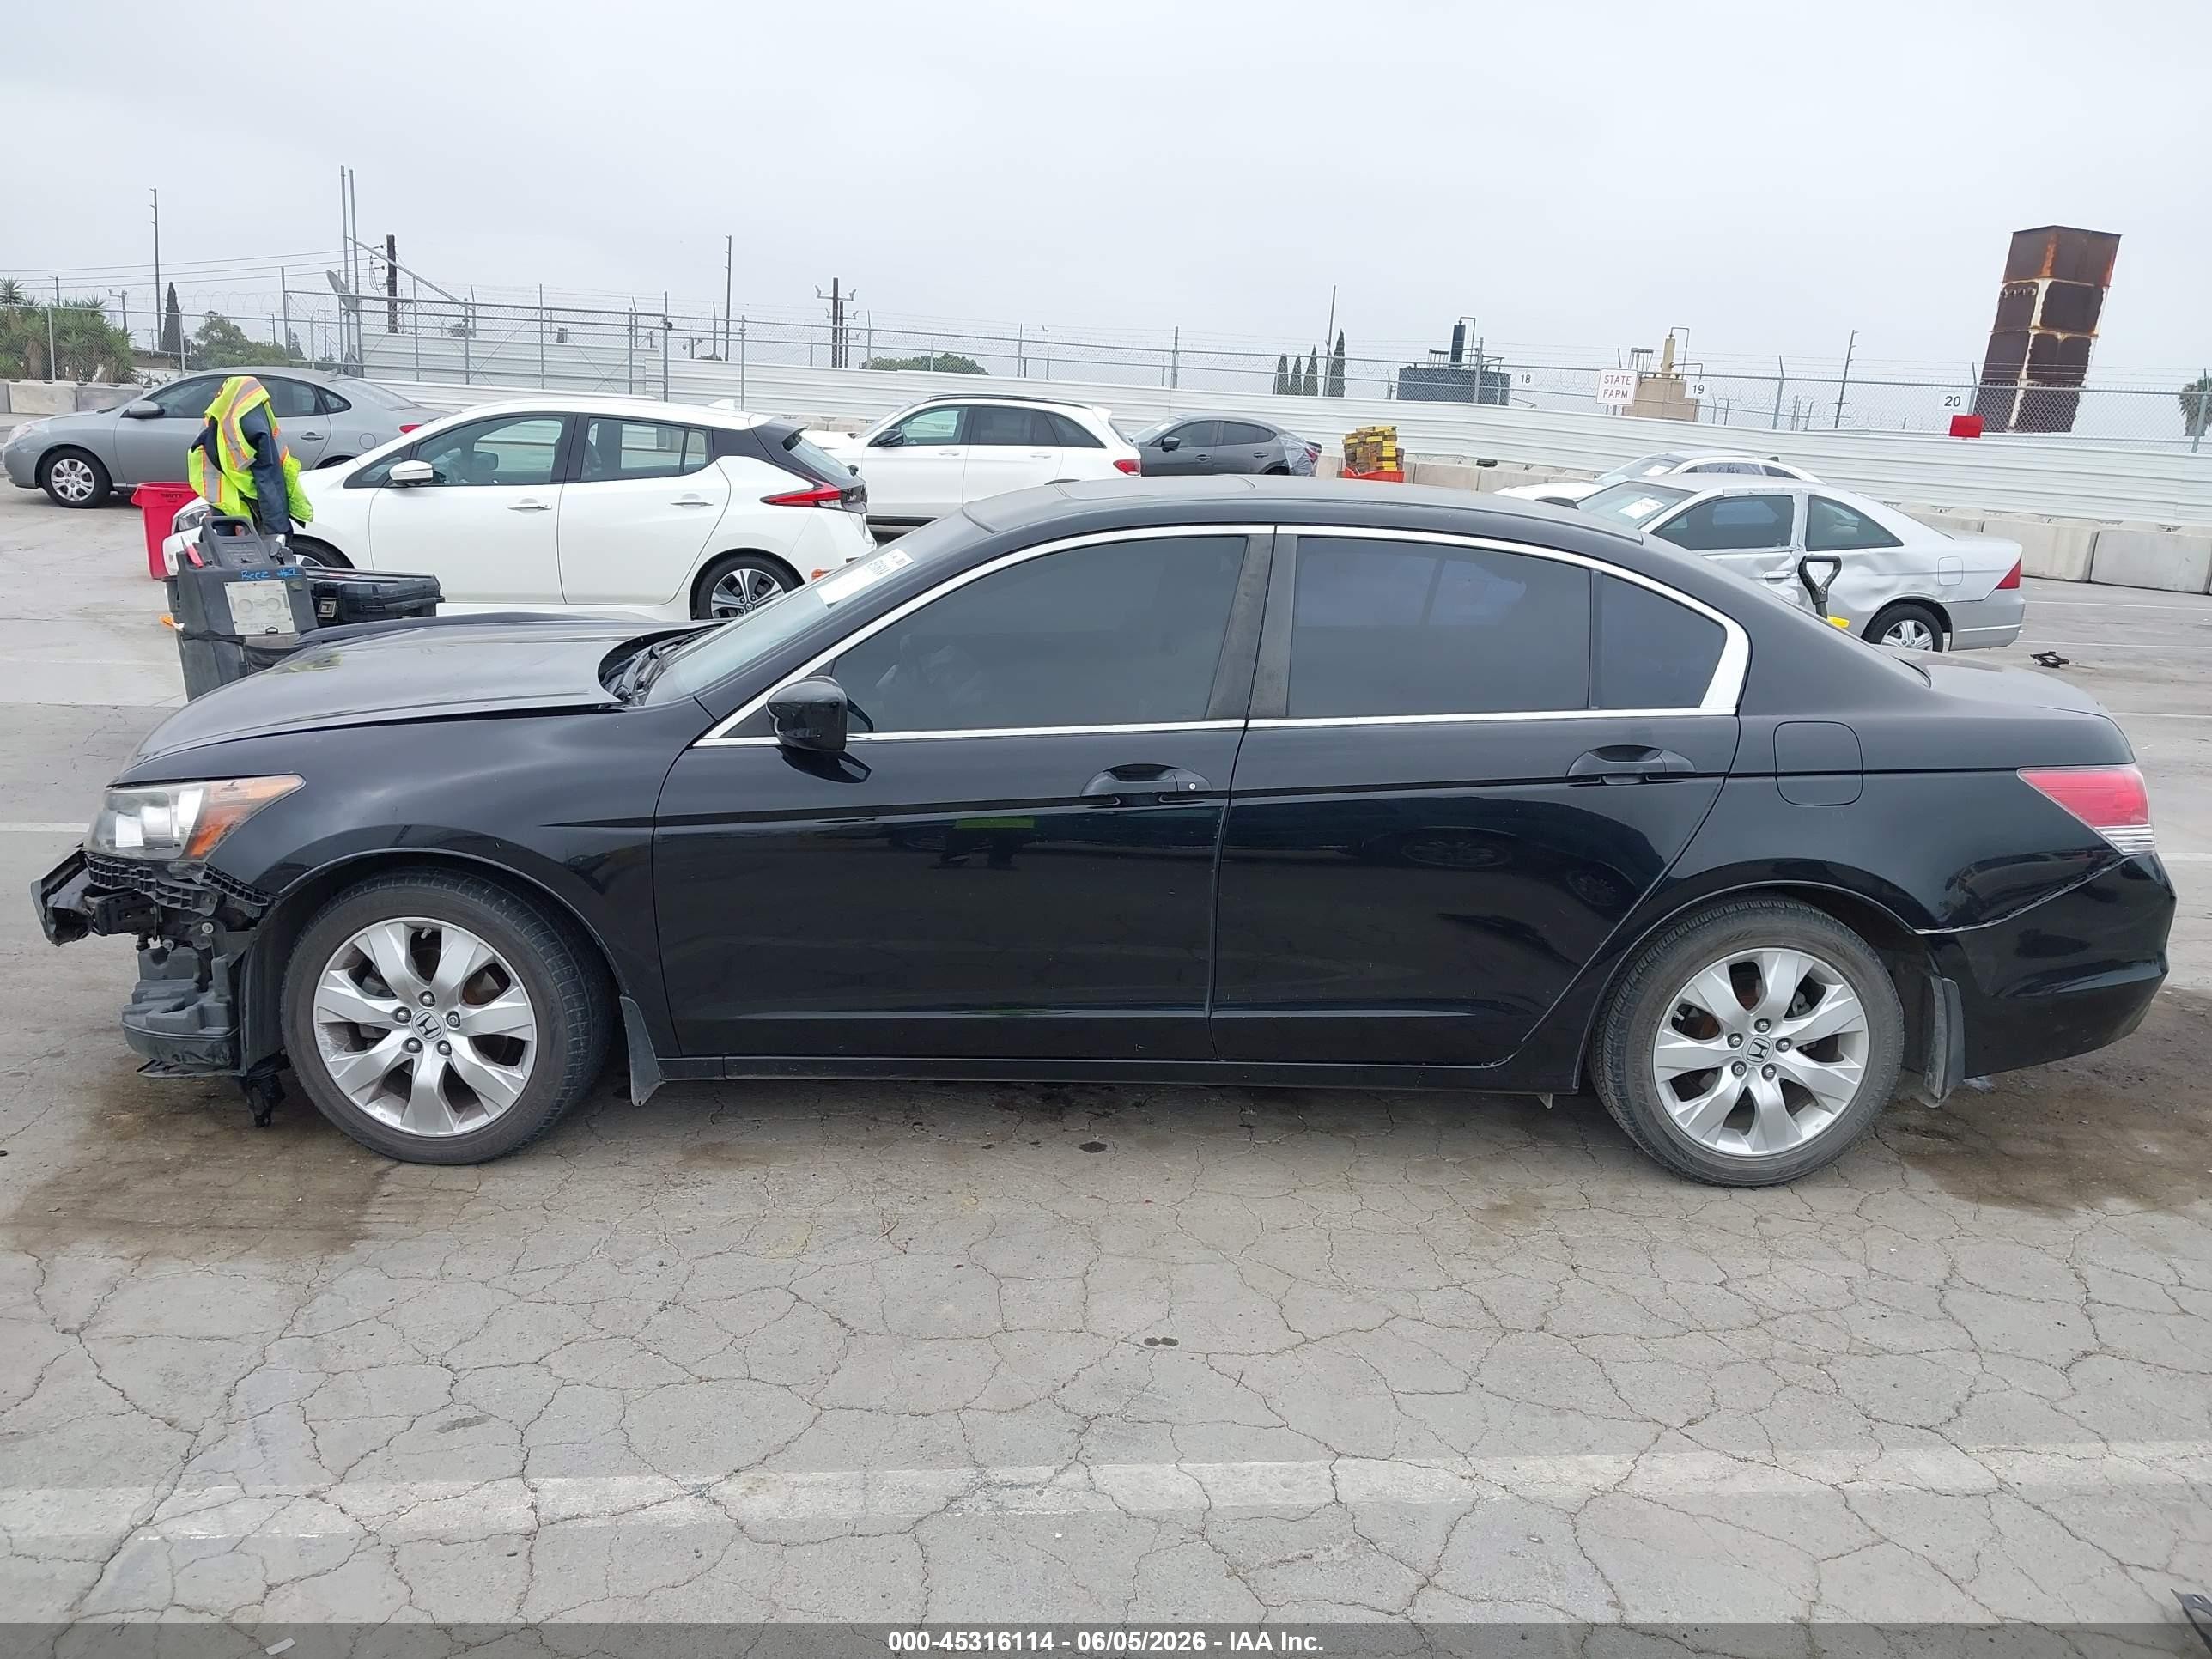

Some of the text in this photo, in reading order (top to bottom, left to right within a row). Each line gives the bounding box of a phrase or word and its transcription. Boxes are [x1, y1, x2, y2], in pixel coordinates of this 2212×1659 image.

[1521, 374, 1531, 384] 18
[1604, 374, 1632, 385] STATE
[1603, 389, 1628, 399] FARM
[1692, 384, 1705, 395] 19
[1943, 395, 1961, 407] 20
